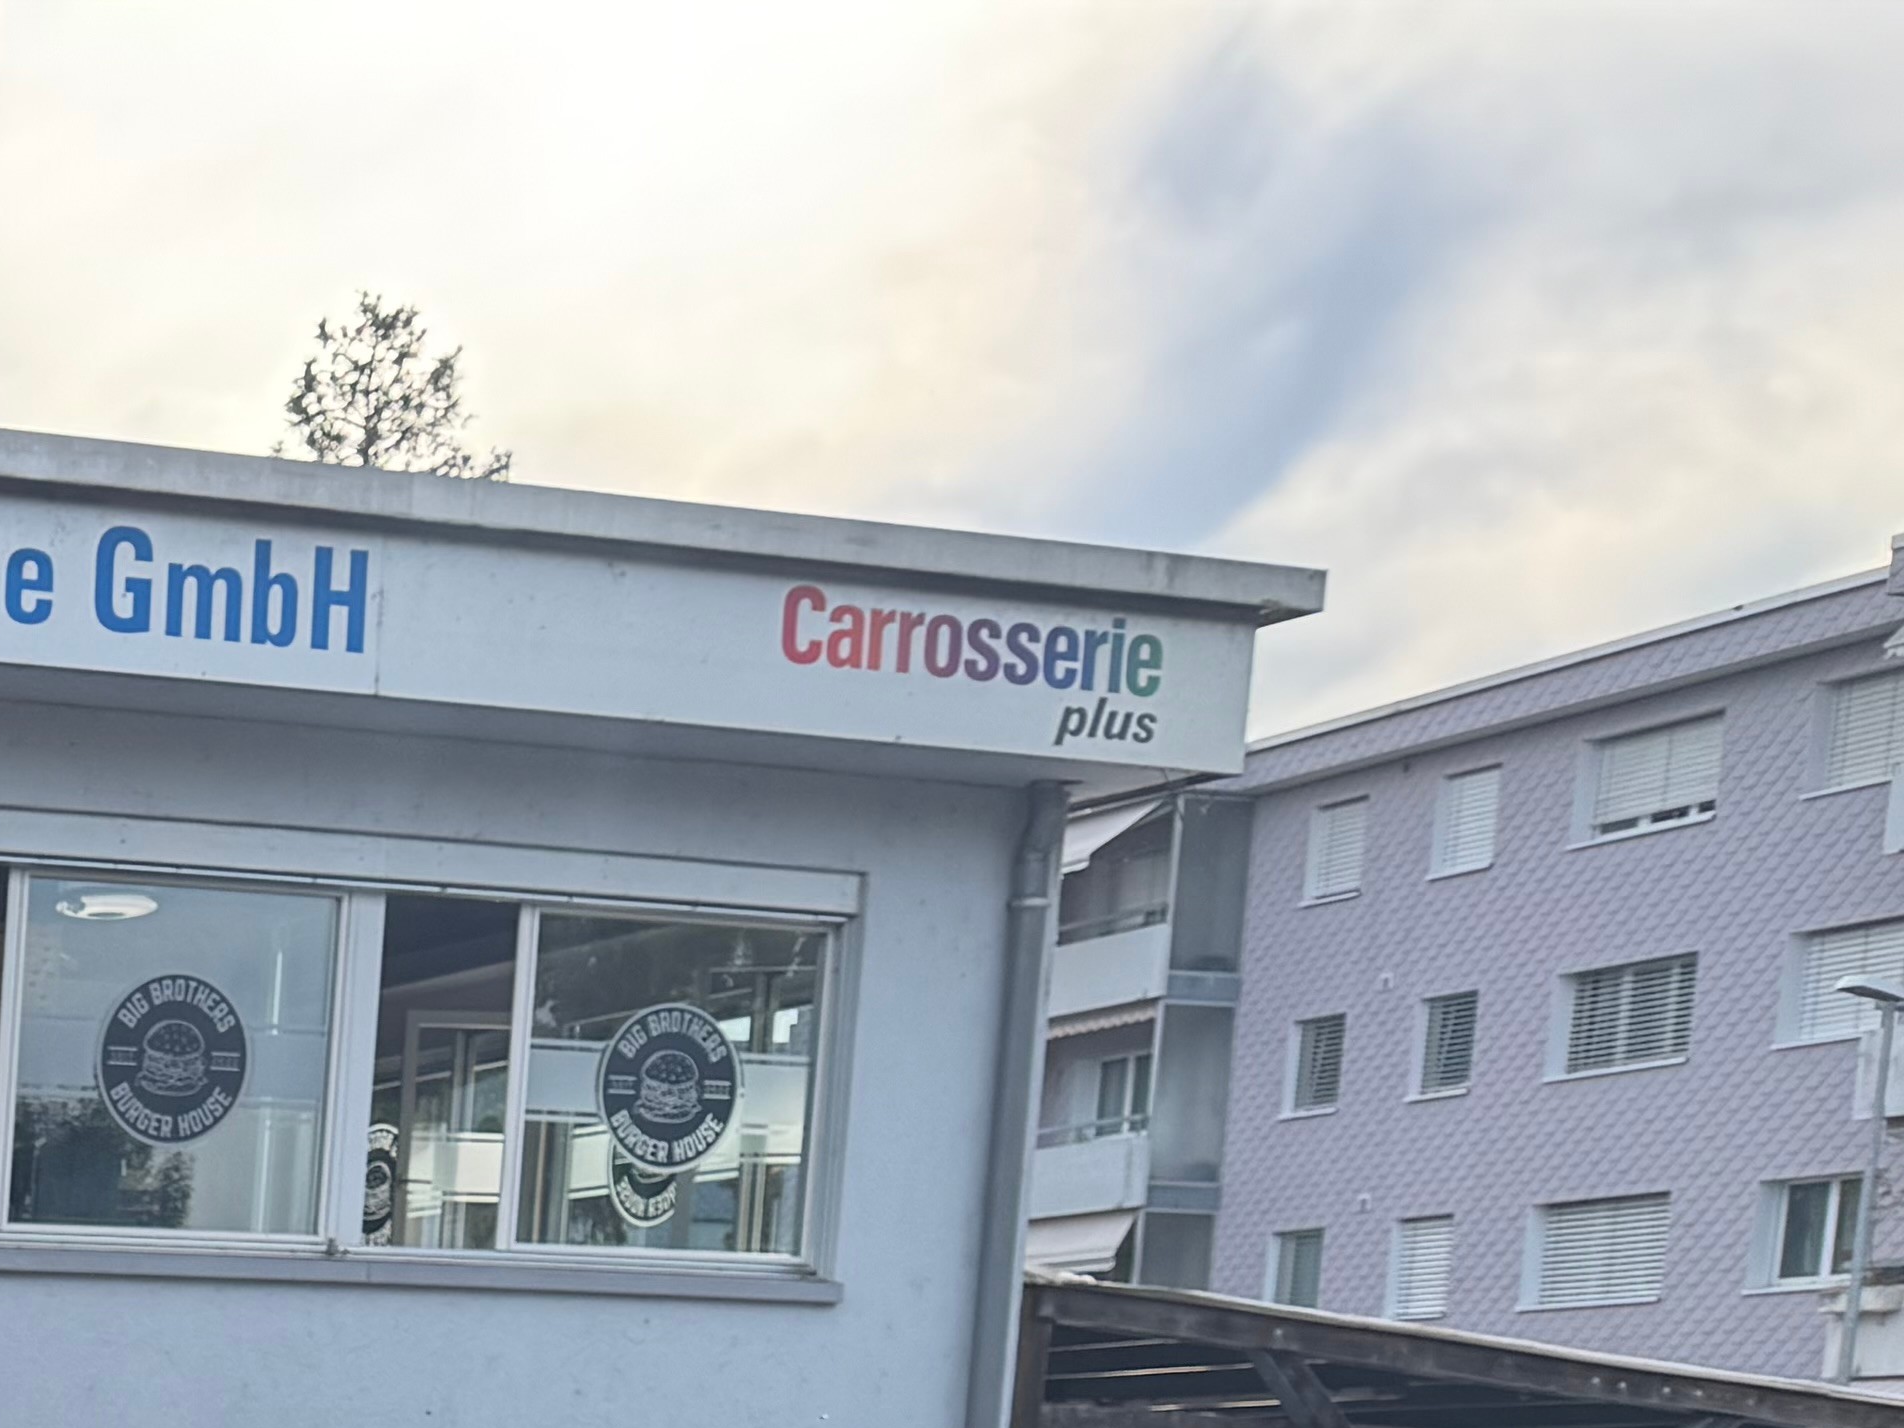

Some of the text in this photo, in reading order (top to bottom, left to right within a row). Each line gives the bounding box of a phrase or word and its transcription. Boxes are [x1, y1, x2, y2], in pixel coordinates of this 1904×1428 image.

[94, 524, 371, 654] GmbH
[781, 585, 1163, 698] Carrosserie
[1052, 697, 1158, 746] plus
[117, 979, 236, 1033] BIG BROTHERS
[617, 1011, 728, 1064] BIG BROTHERS
[110, 1081, 233, 1138] BURGER HOUSE
[610, 1109, 724, 1164] BURGER HOUSE
